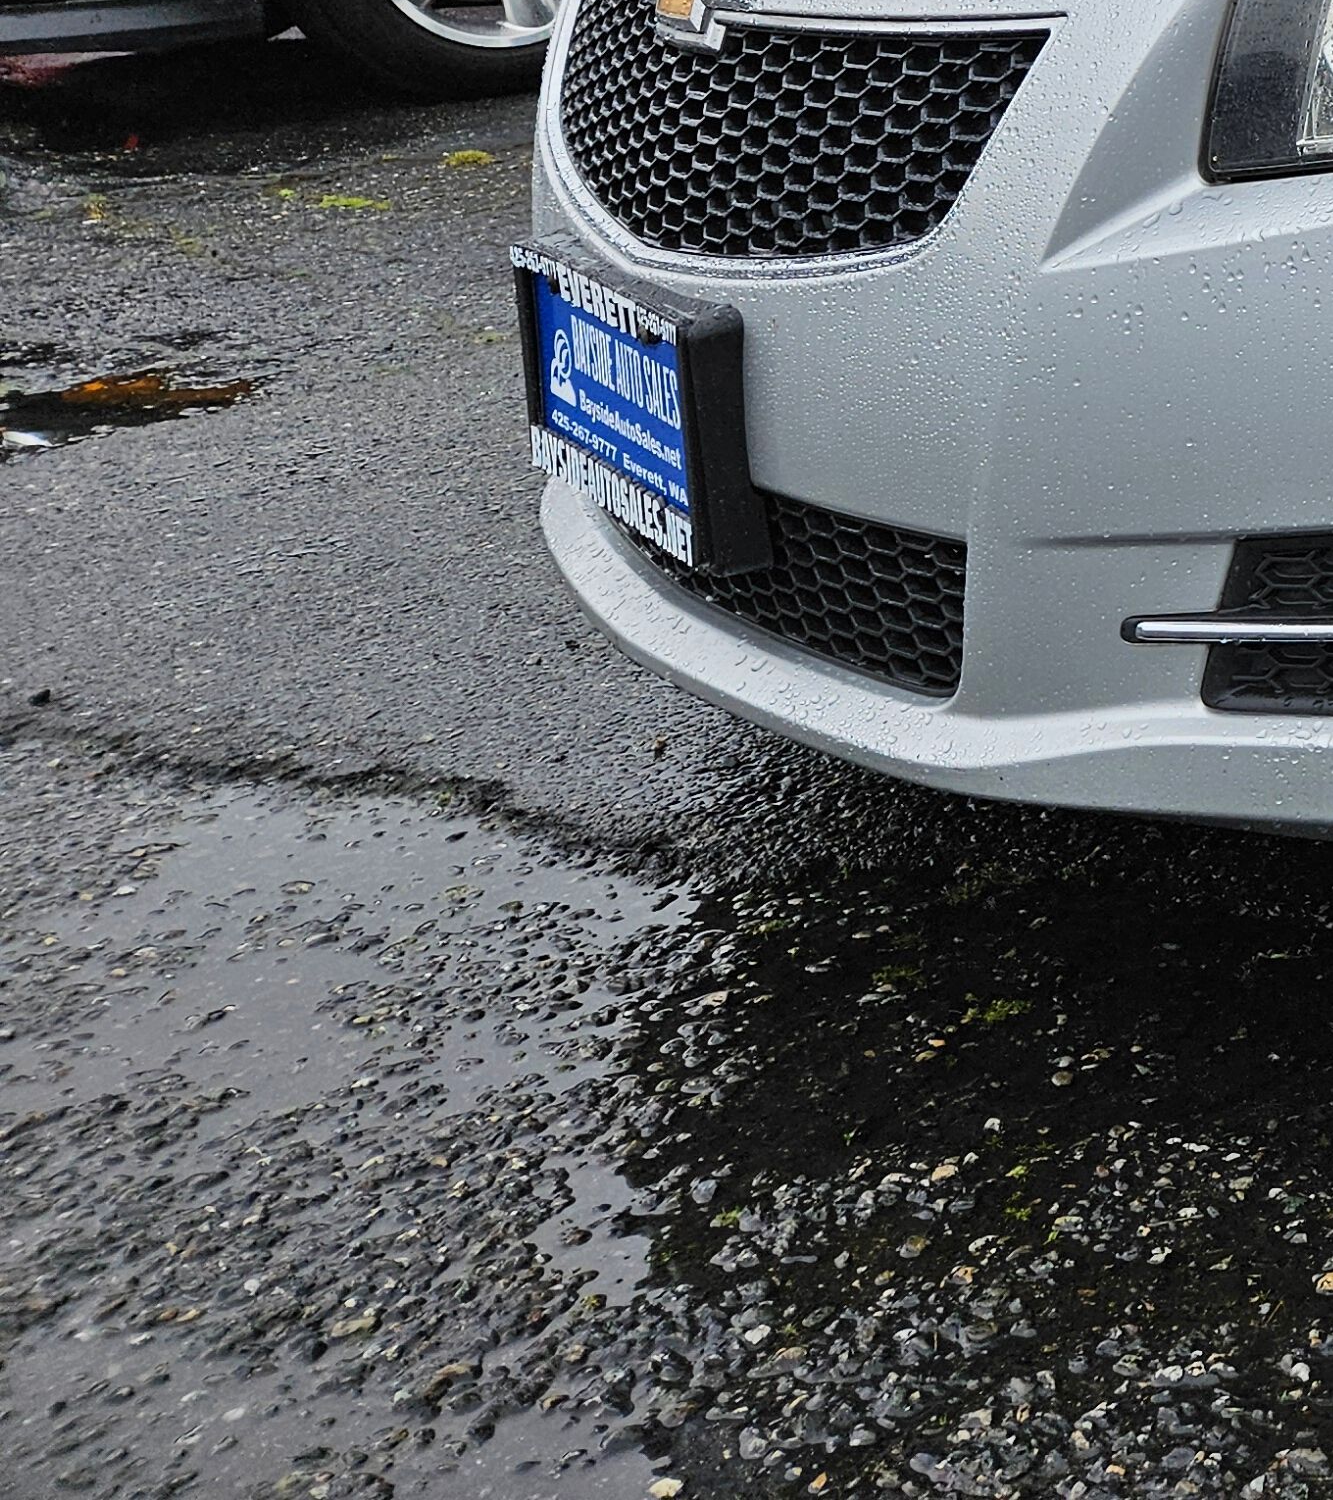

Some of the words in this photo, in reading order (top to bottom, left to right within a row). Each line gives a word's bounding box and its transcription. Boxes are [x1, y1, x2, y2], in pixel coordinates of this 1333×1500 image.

[555, 261, 638, 339] EVERETT
[570, 313, 615, 387] BAYSIDE
[614, 338, 645, 410] AUTO
[643, 357, 682, 431] SALES
[551, 409, 618, 462] 425-267-9777
[622, 451, 668, 497] Everett,
[668, 483, 690, 507] WA
[578, 388, 683, 470] BaysideAutoSales.net
[531, 424, 694, 567] BAYSIDEAUTOSALES.NET
